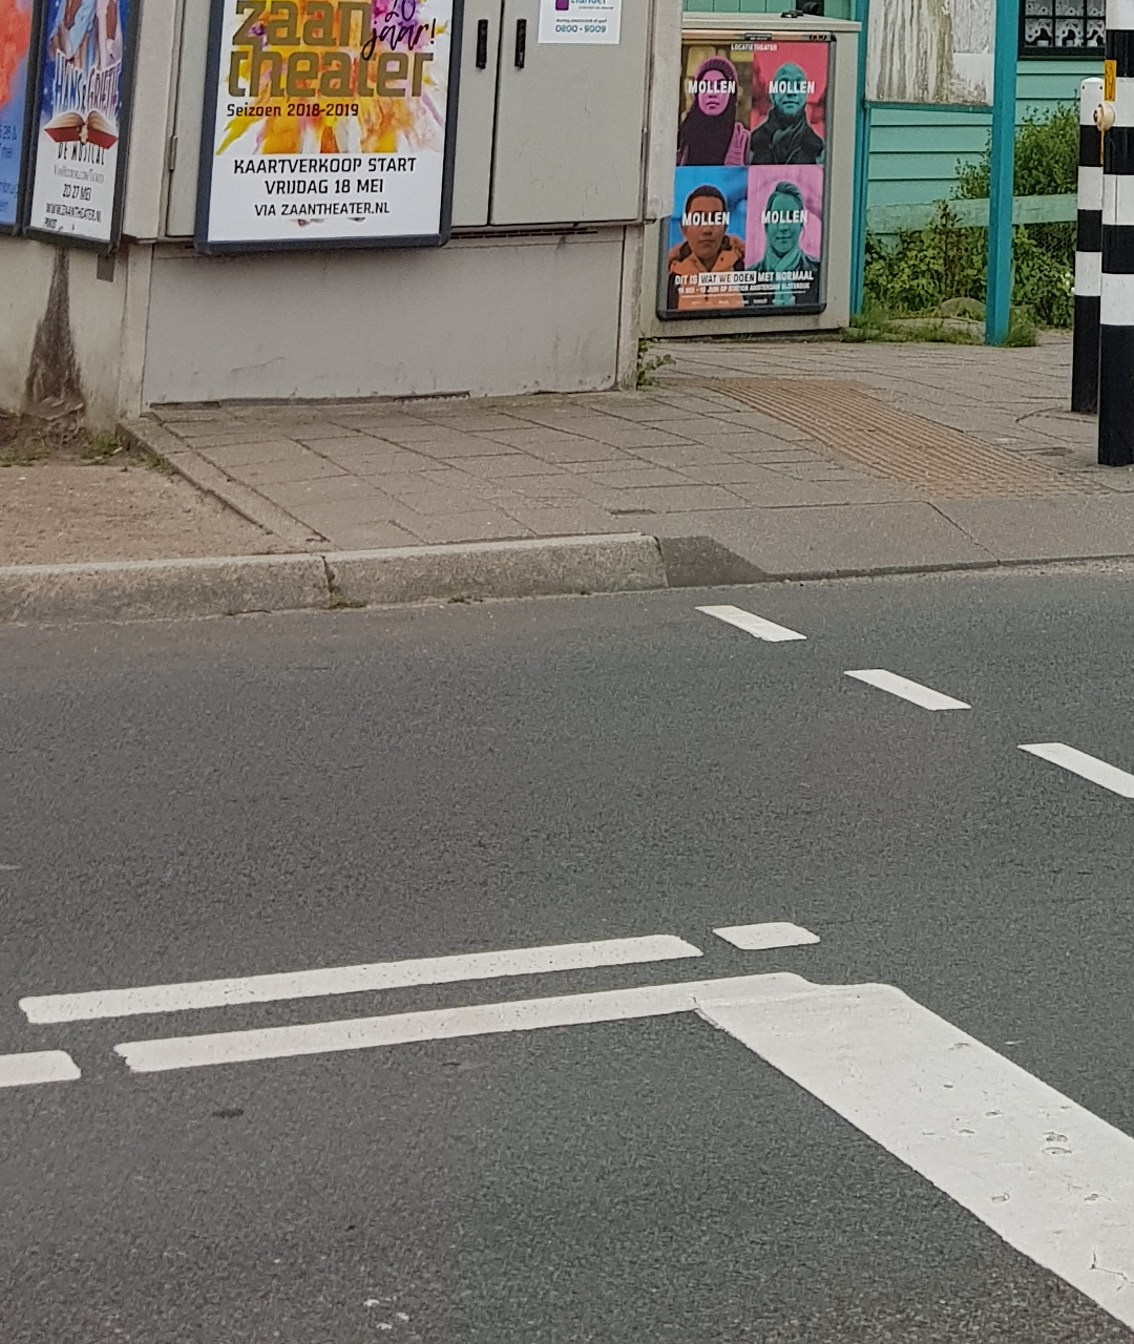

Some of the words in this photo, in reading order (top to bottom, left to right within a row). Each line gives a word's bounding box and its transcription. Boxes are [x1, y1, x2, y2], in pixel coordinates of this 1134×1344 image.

[232, 0, 372, 46] zaan
[361, 18, 437, 61] jaar!
[555, 24, 578, 33] 0800
[228, 44, 434, 97] theater
[688, 80, 736, 94] MOLLEN
[769, 80, 815, 94] MOLLEN
[227, 103, 281, 117] Seizoen
[287, 103, 359, 117] 2018-2019
[234, 158, 362, 174] KAARTVERKOOP
[368, 157, 417, 172] START
[265, 179, 328, 195] VRIJDAG
[335, 180, 350, 194] 18
[357, 178, 383, 193] MEI
[254, 204, 276, 216] VIA
[281, 202, 390, 216] ZAANTHEATER.NL
[682, 211, 731, 226] MOLLEN
[761, 210, 808, 224] MOLLEN
[675, 274, 688, 286] DIT
[700, 274, 717, 283] WAT
[719, 274, 731, 283] WE
[733, 273, 755, 283] DOEN
[758, 272, 774, 282] MET
[775, 270, 814, 281] NORMAAL
